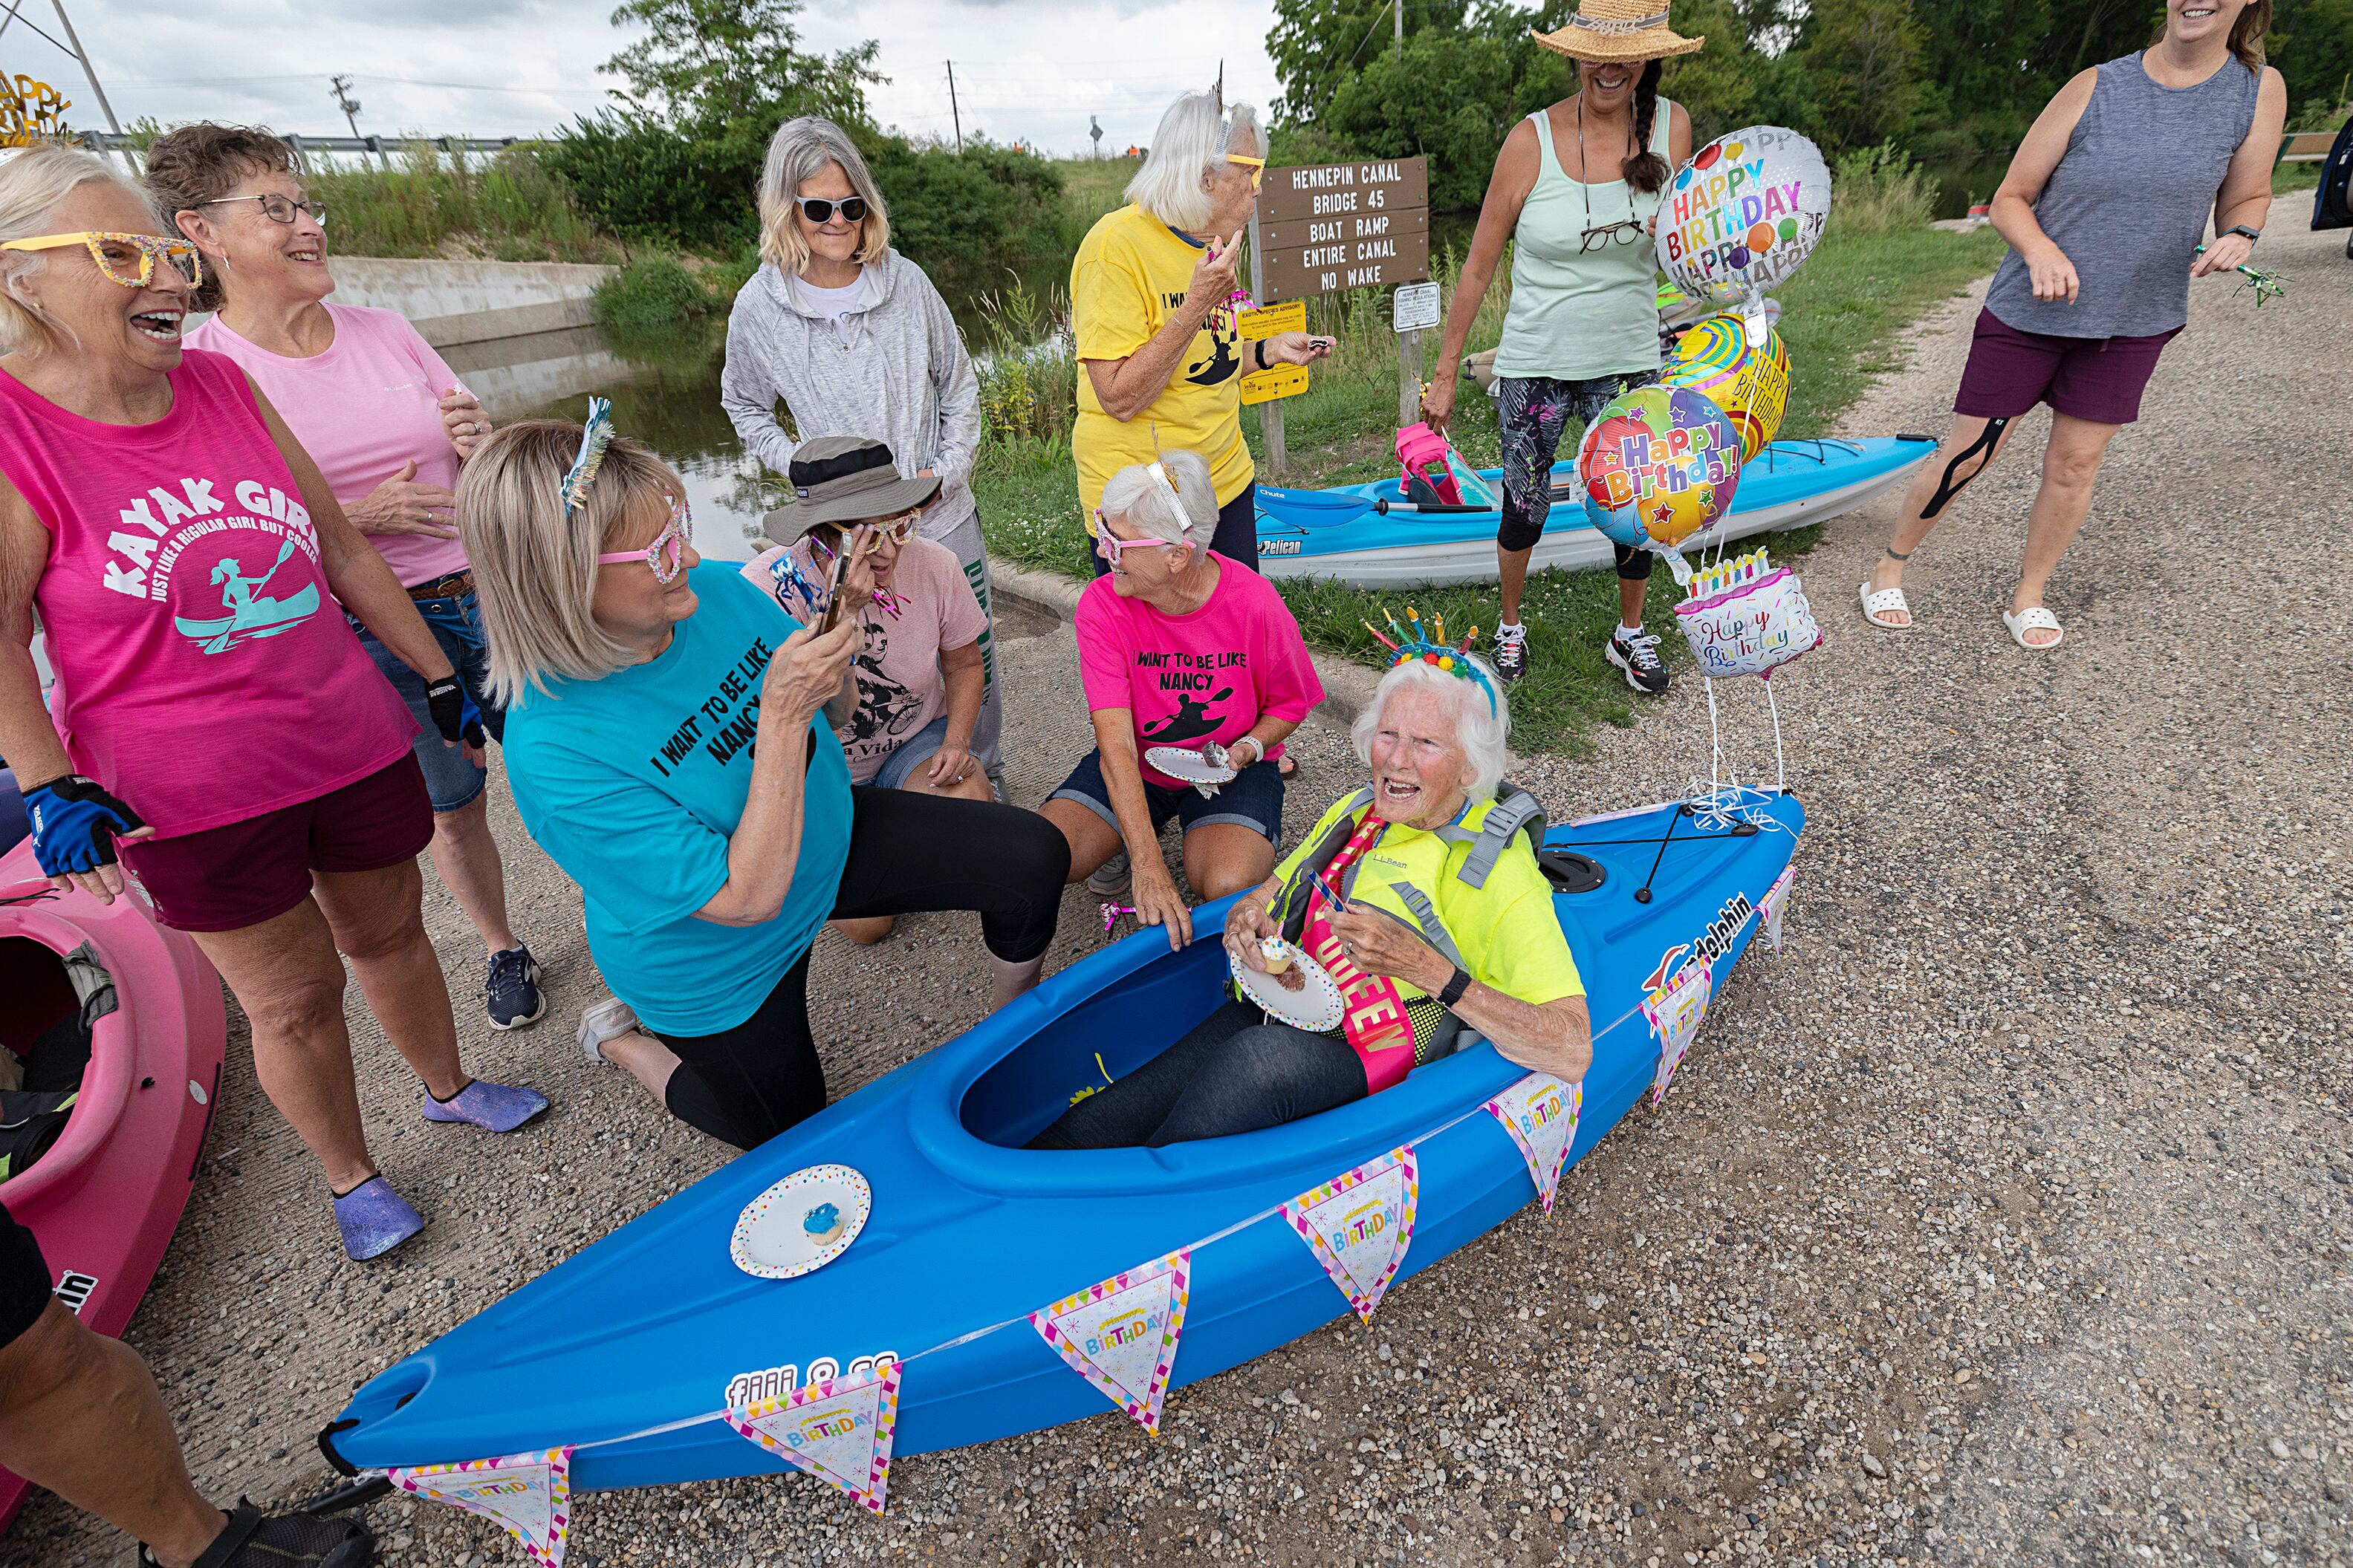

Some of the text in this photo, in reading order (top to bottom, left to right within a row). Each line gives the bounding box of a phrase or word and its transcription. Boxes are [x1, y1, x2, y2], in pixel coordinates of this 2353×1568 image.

[0, 70, 72, 117] APPY
[1292, 163, 1402, 189] HENNEPIN CANAL
[1313, 189, 1384, 215] BRIDGE 45
[1672, 158, 1765, 227] HAPPY
[1310, 216, 1389, 243] BOAT RAMP
[1666, 180, 1802, 262] BIRTHDAY
[1303, 238, 1397, 268] ENTIRE CANAL
[1321, 266, 1381, 290] NO WAKE
[1162, 292, 1187, 309] I WA
[1242, 303, 1301, 319] EXOTIC SPECIES ADVISORY
[1752, 355, 1788, 403] HAPPY
[1622, 423, 1721, 468] Happy
[1606, 446, 1738, 504] Birthday!
[1259, 489, 1285, 499] Chute
[103, 478, 225, 599] KAYAK
[1262, 539, 1302, 556] Pelican
[152, 516, 319, 603] JUST LIKE A REGULAR GIRL BUT COOLER
[1701, 611, 1770, 645] Happy
[1137, 651, 1171, 668] WANT
[1174, 652, 1192, 668] TO
[1196, 654, 1215, 669] BE
[1218, 651, 1247, 668] LIKE
[1704, 630, 1788, 667] Birthday
[1160, 672, 1214, 692] NANCY
[650, 636, 773, 778] I WANT TO BE LIKE
[706, 694, 760, 767] NANCY
[858, 738, 903, 756] Vida
[1373, 854, 1407, 869] L.L.Bean
